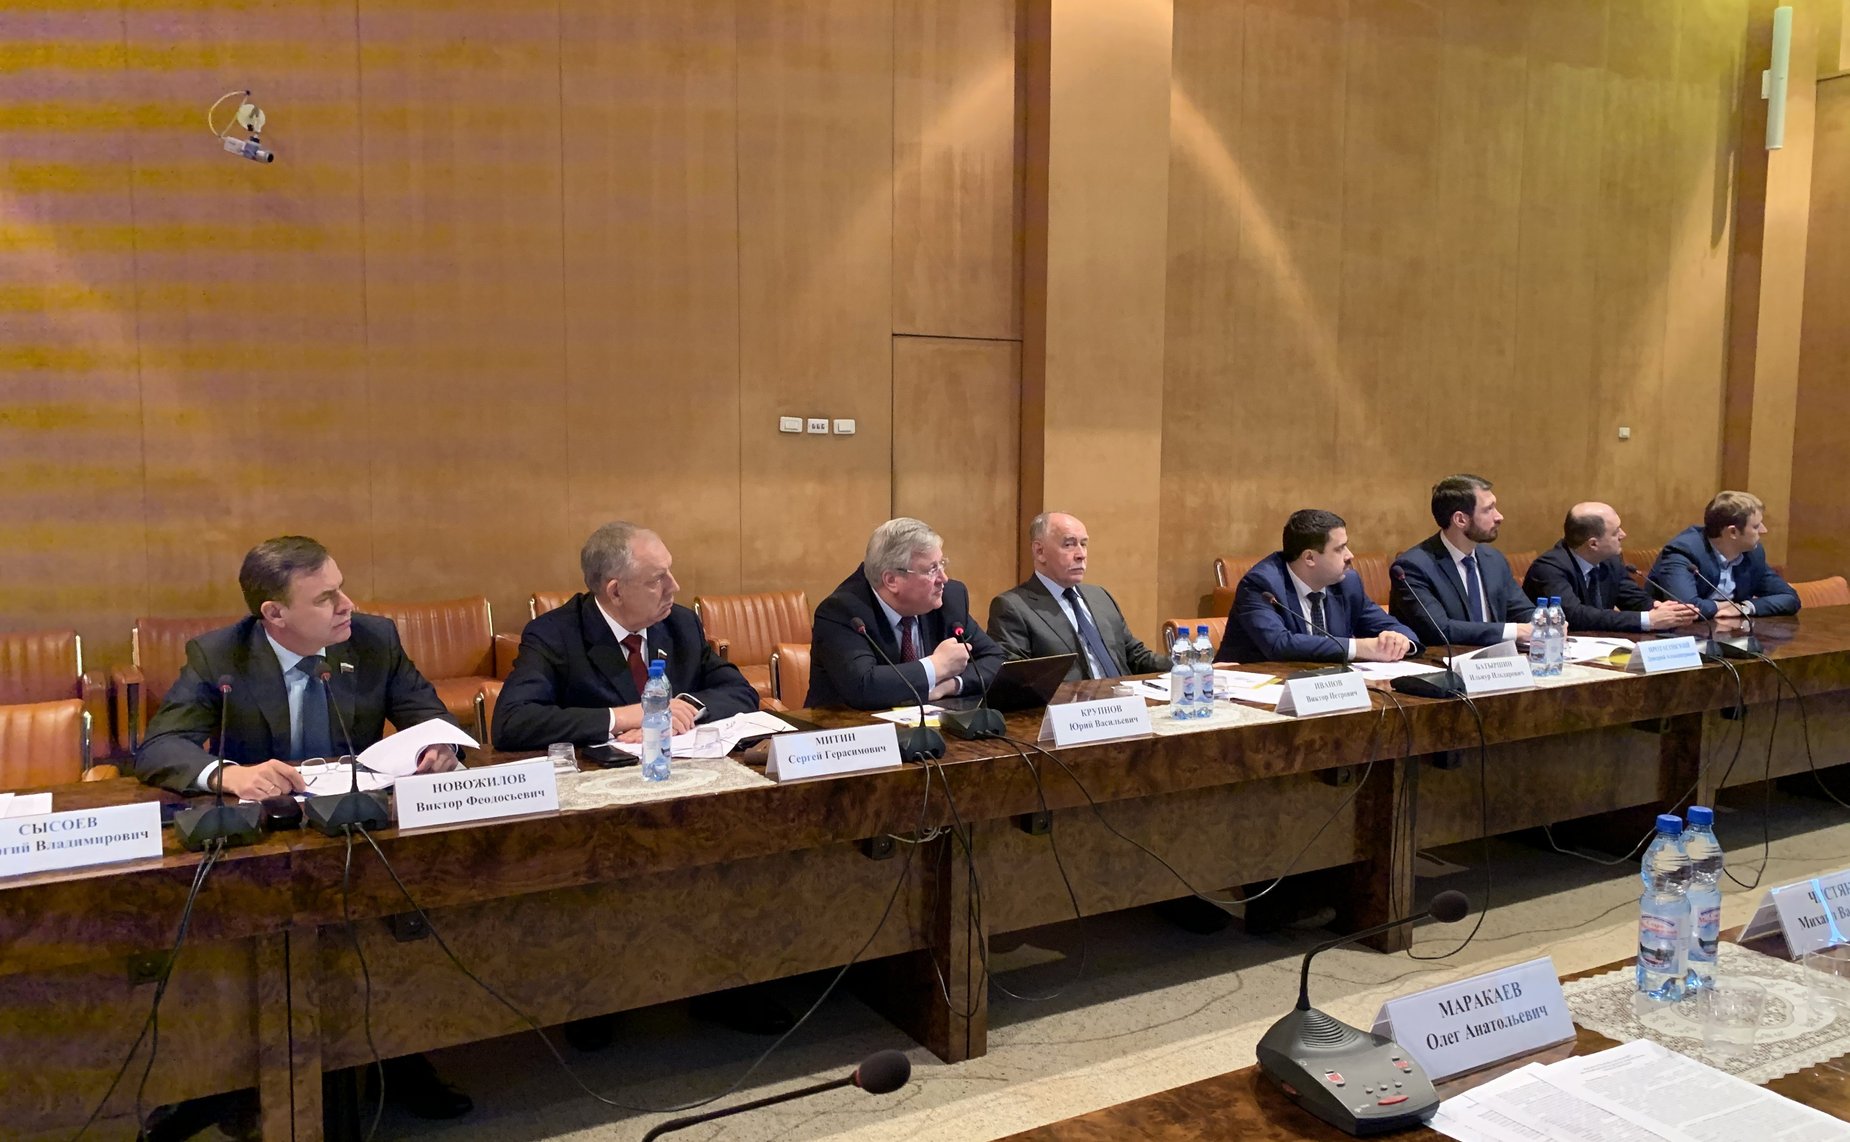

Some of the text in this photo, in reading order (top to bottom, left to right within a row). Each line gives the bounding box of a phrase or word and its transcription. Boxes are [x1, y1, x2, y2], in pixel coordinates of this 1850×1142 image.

[1314, 679, 1344, 691] ИВАНОВ
[1306, 690, 1359, 704] Виктор Петрович
[1081, 704, 1123, 718] КРУПНОВ
[1069, 716, 1139, 733] Юрий Васильевич
[815, 732, 857, 747] МИТИН
[788, 744, 887, 765] Сергей Герасимович
[432, 772, 527, 794] НОВОЖИЛОВ
[416, 788, 546, 813] Виктор Феодосьевич
[18, 816, 98, 836] СЫСОЕВ
[0, 829, 149, 856] гий Владимирович
[1438, 981, 1523, 1019] МАРАКАЕВ
[1426, 1004, 1549, 1051] Олег Анатольевич
